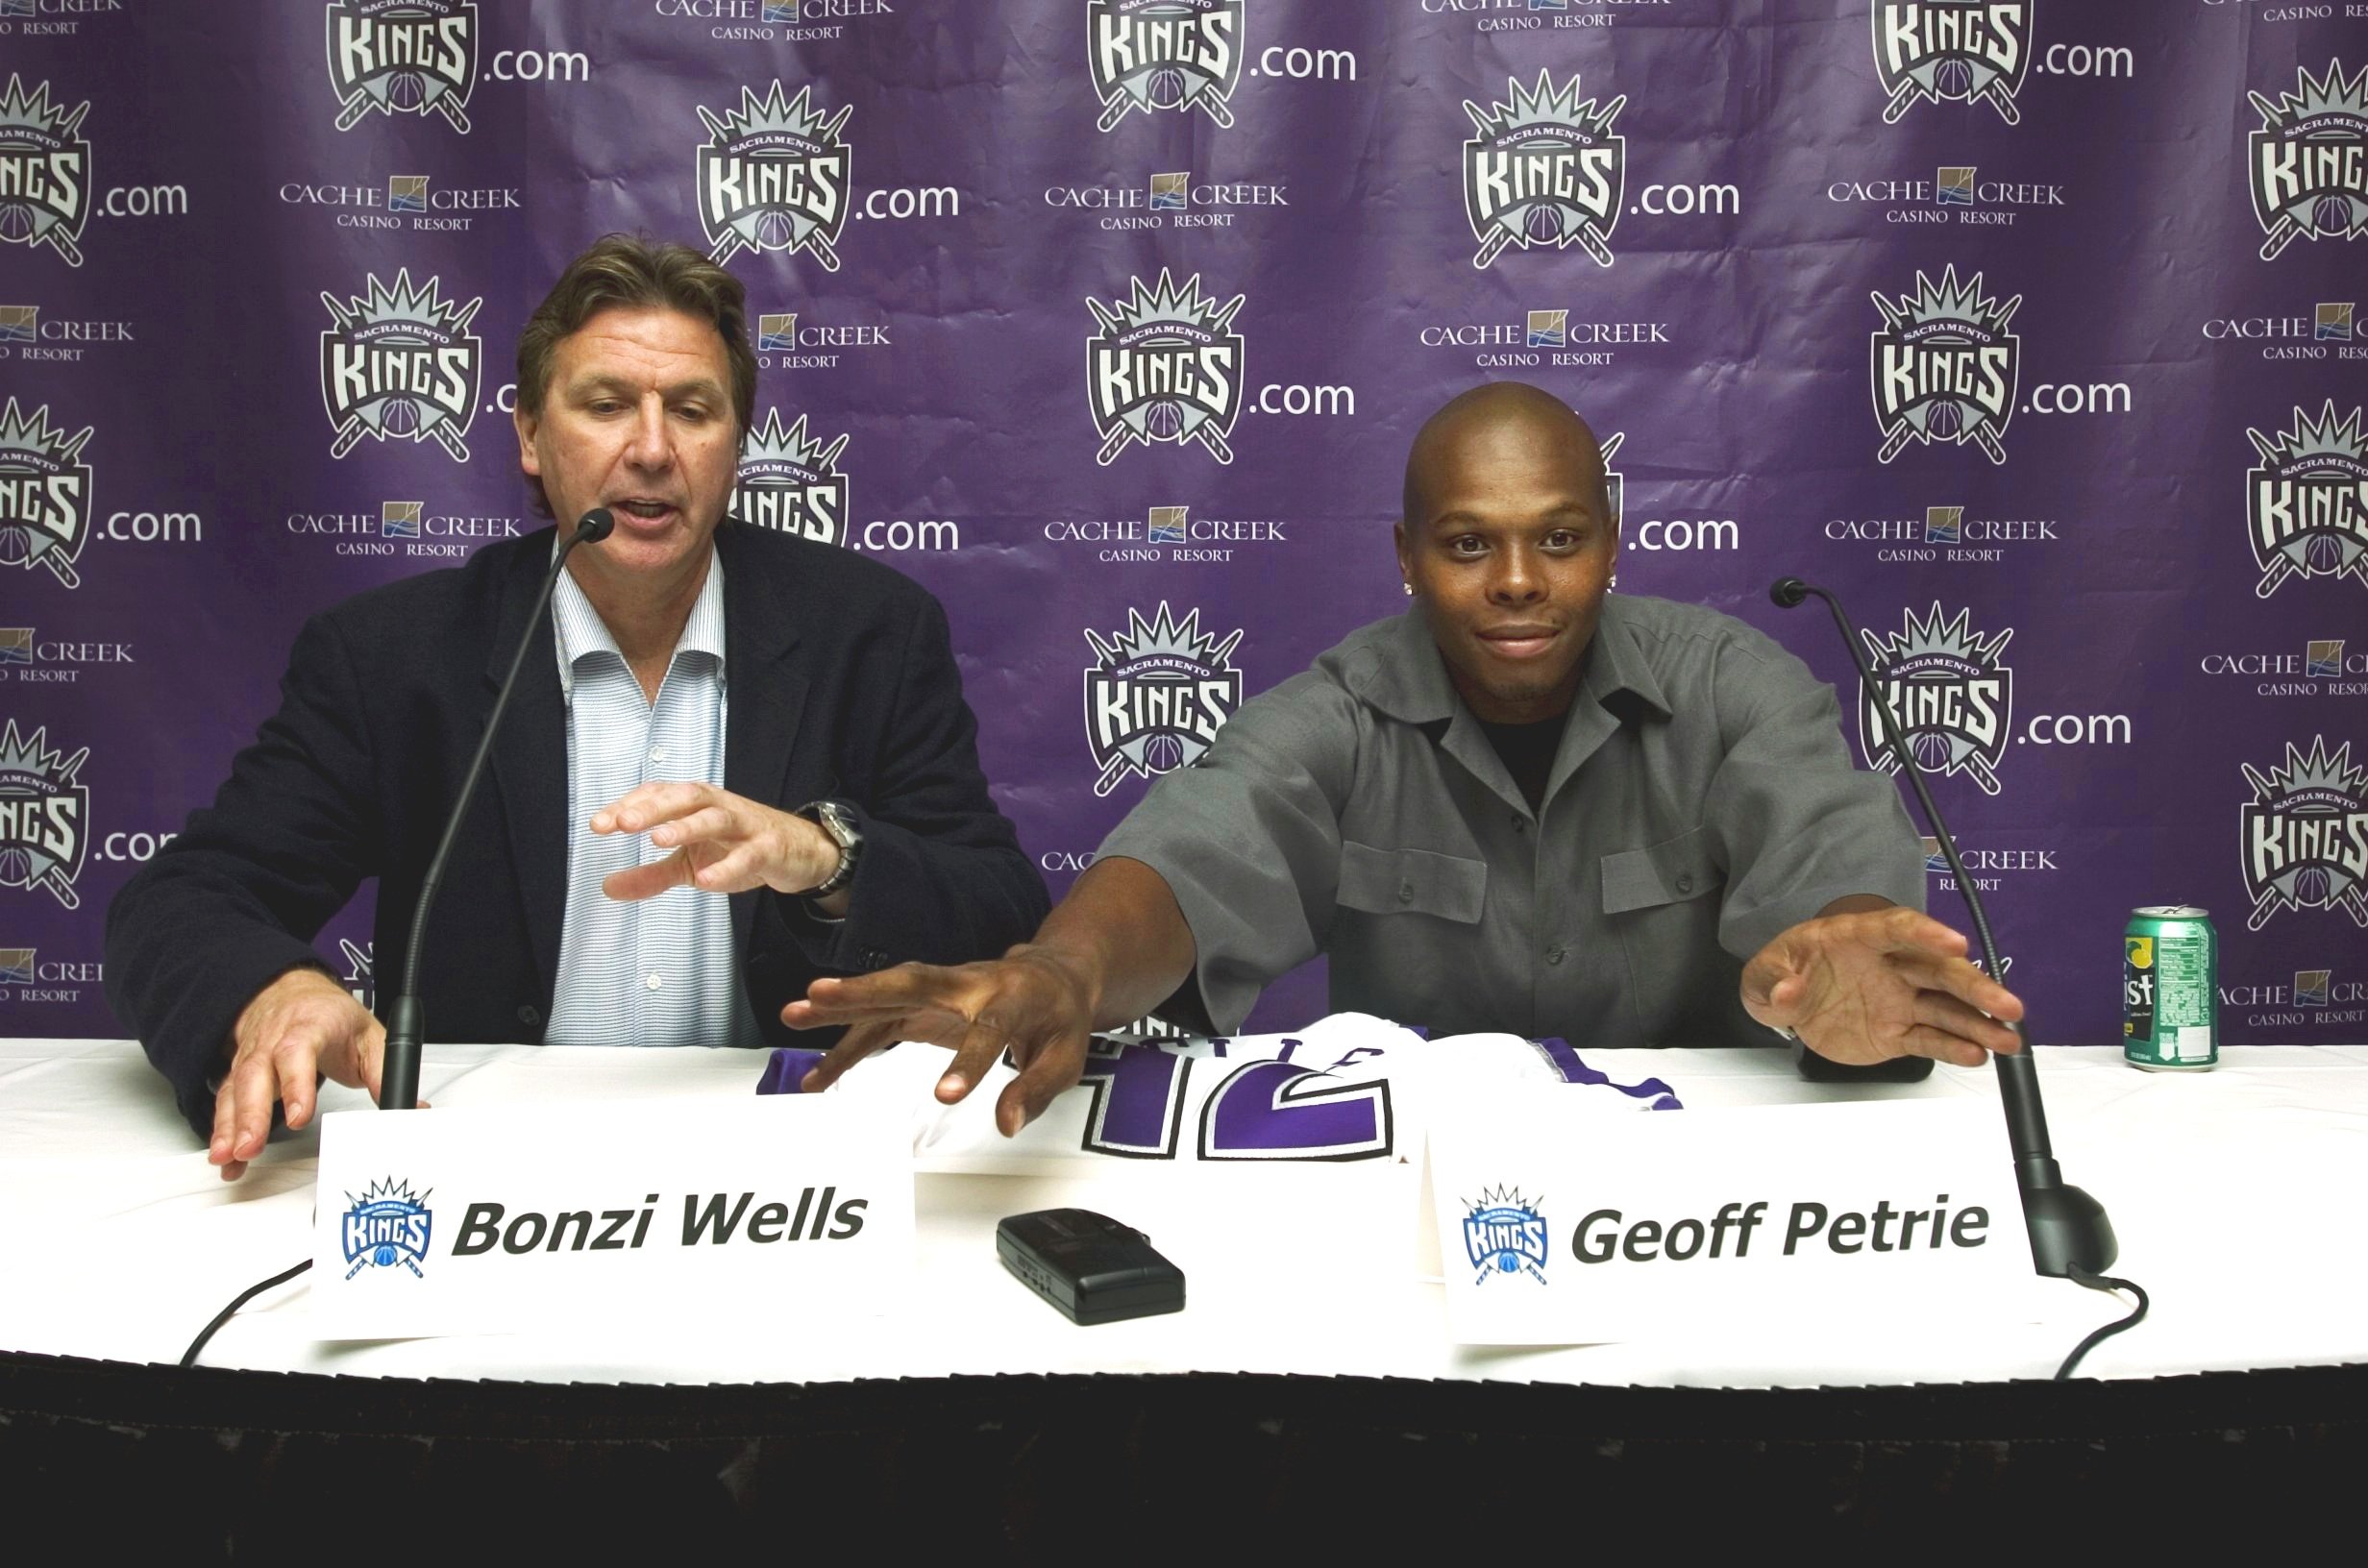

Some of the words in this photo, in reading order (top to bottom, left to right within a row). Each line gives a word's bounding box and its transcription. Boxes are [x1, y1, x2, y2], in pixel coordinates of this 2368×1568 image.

[656, 0, 753, 18] CACHE
[800, 0, 894, 17] CREEK
[2264, 6, 2331, 21] CASINO
[23, 22, 78, 34] RESORT
[712, 27, 774, 39] CASINO
[785, 22, 843, 40] RESORT
[1478, 17, 1541, 31] CASINO
[1554, 14, 1616, 28] RESORT
[1097, 12, 1231, 85] KINGS
[1883, 3, 2021, 74] KINGS
[337, 15, 468, 85] KINGS
[2036, 44, 2133, 77] .com
[484, 51, 588, 81] .com
[1250, 47, 1355, 81] .com
[728, 135, 823, 155] SACRAMENTO
[1495, 127, 1591, 147] SACRAMENTO
[1475, 147, 1615, 219] KINGS
[2263, 142, 2368, 212] KING
[97, 185, 186, 216] .com
[281, 184, 382, 207] CACHE
[432, 189, 520, 208] CREEK
[708, 158, 839, 225] KINGS
[1045, 188, 1143, 208] CACHE
[1192, 184, 1288, 205] CREEK
[1631, 184, 1739, 214] .com
[1828, 182, 1929, 202] CACHE
[1978, 183, 2063, 205] CREEK
[855, 187, 958, 219] .com
[337, 215, 401, 229] CASINO
[413, 216, 473, 232] RESORT
[1100, 216, 1162, 230] CASINO
[1174, 214, 1234, 227] RESORT
[1887, 210, 1948, 223] CASINO
[1961, 211, 2015, 225] RESORT
[41, 322, 133, 340] CREEK
[354, 324, 450, 345] SACRAMENTO
[800, 327, 890, 346] CREEK
[1118, 325, 1213, 346] SACRAMENTO
[1420, 326, 1519, 346] CACHE
[1571, 324, 1668, 343] CREEK
[1902, 322, 1993, 344] SACRAMENTO
[2203, 318, 2306, 338] CACHE
[22, 348, 84, 360] RESORT
[783, 355, 839, 368] RESORT
[1477, 354, 1539, 366] CASINO
[1553, 353, 1614, 365] RESORT
[2263, 347, 2327, 358] CASINO
[332, 344, 469, 411] KINGS
[1097, 346, 1231, 420] KINGS
[1883, 346, 2009, 417] KINGS
[485, 383, 517, 413] .c
[1249, 384, 1354, 415] .com
[2023, 383, 2131, 413] .com
[0, 452, 60, 472] AMENTO
[97, 512, 201, 541] .com
[288, 515, 375, 533] CACHE
[426, 517, 521, 536] CREEK
[853, 522, 958, 550] .com
[1045, 522, 1142, 540] CACHE
[1192, 521, 1285, 540] CREEK
[1629, 521, 1738, 550] .com
[1825, 521, 1918, 539] CACHE
[1965, 522, 2058, 539] CREEK
[336, 544, 394, 554] CASINO
[407, 544, 468, 556] RESORT
[1099, 550, 1160, 561] CASINO
[1173, 550, 1233, 561] RESORT
[1878, 550, 1936, 561] CASINO
[1948, 550, 2004, 561] RESORT
[37, 643, 133, 662] CREEK
[1117, 658, 1212, 678] SACRAMENTO
[1889, 657, 1982, 679] SACRAMENTO
[2202, 655, 2299, 674] CACHE
[20, 670, 79, 682] RESORT
[2257, 684, 2317, 695] CASINO
[2018, 715, 2131, 744] .com
[0, 772, 58, 795] AMENTO
[2271, 792, 2359, 811] SACRAMENTO
[2252, 815, 2368, 883] KINGS
[1960, 851, 2057, 869] CREEK
[1940, 879, 2001, 891] REORT
[38, 963, 102, 981] CRE
[21, 990, 80, 1001] RESORT
[2216, 985, 2287, 1005] ACHE
[2249, 1014, 2304, 1026] CASINO
[2315, 1011, 2362, 1023] RESORT
[452, 1194, 659, 1256] Bonzi
[682, 1187, 868, 1245] Wells
[1572, 1202, 1767, 1263] Geoff
[1784, 1194, 1988, 1255] Petrie
[347, 1213, 427, 1256] KINGS
[1467, 1220, 1543, 1262] KINGS
